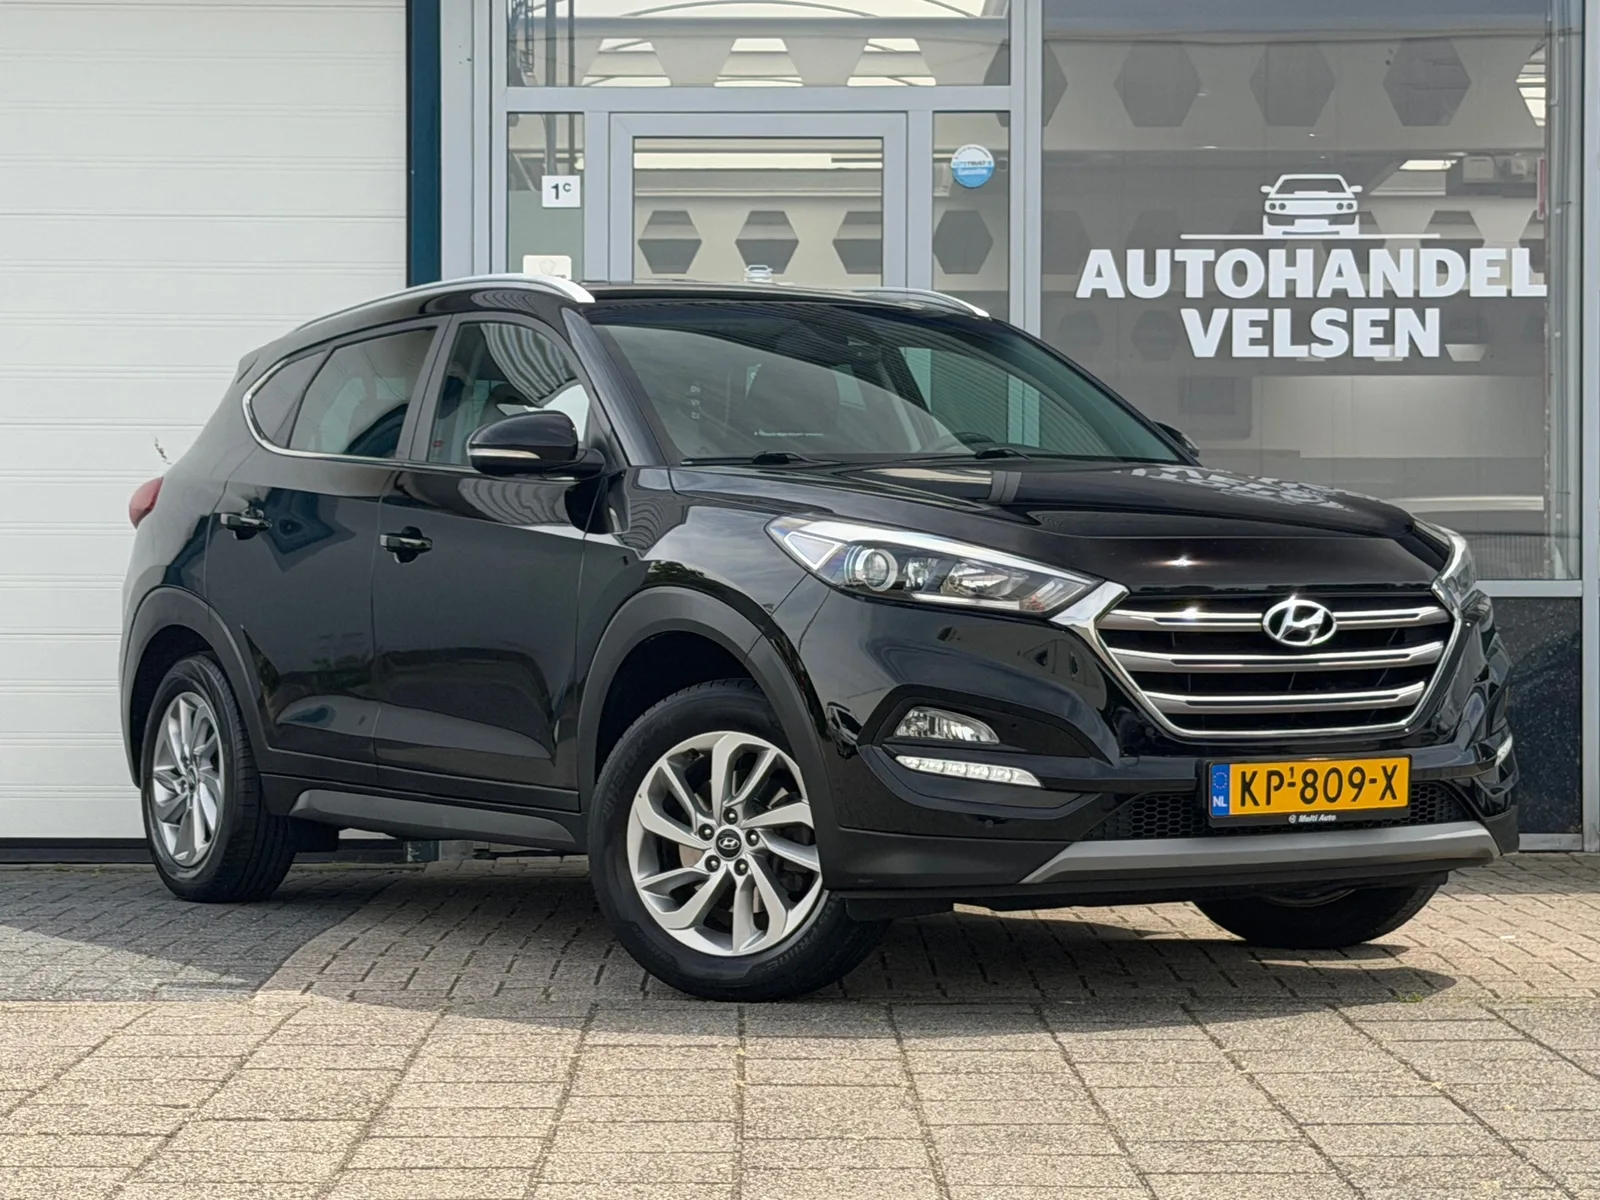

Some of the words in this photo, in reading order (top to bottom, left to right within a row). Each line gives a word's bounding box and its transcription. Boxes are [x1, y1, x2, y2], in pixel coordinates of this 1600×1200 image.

[1075, 248, 1547, 299] AUTOHANDEL
[1180, 307, 1441, 358] VELSEN
[1213, 796, 1228, 808] NL
[1298, 814, 1318, 822] Multi
[1319, 814, 1337, 822] Auto
